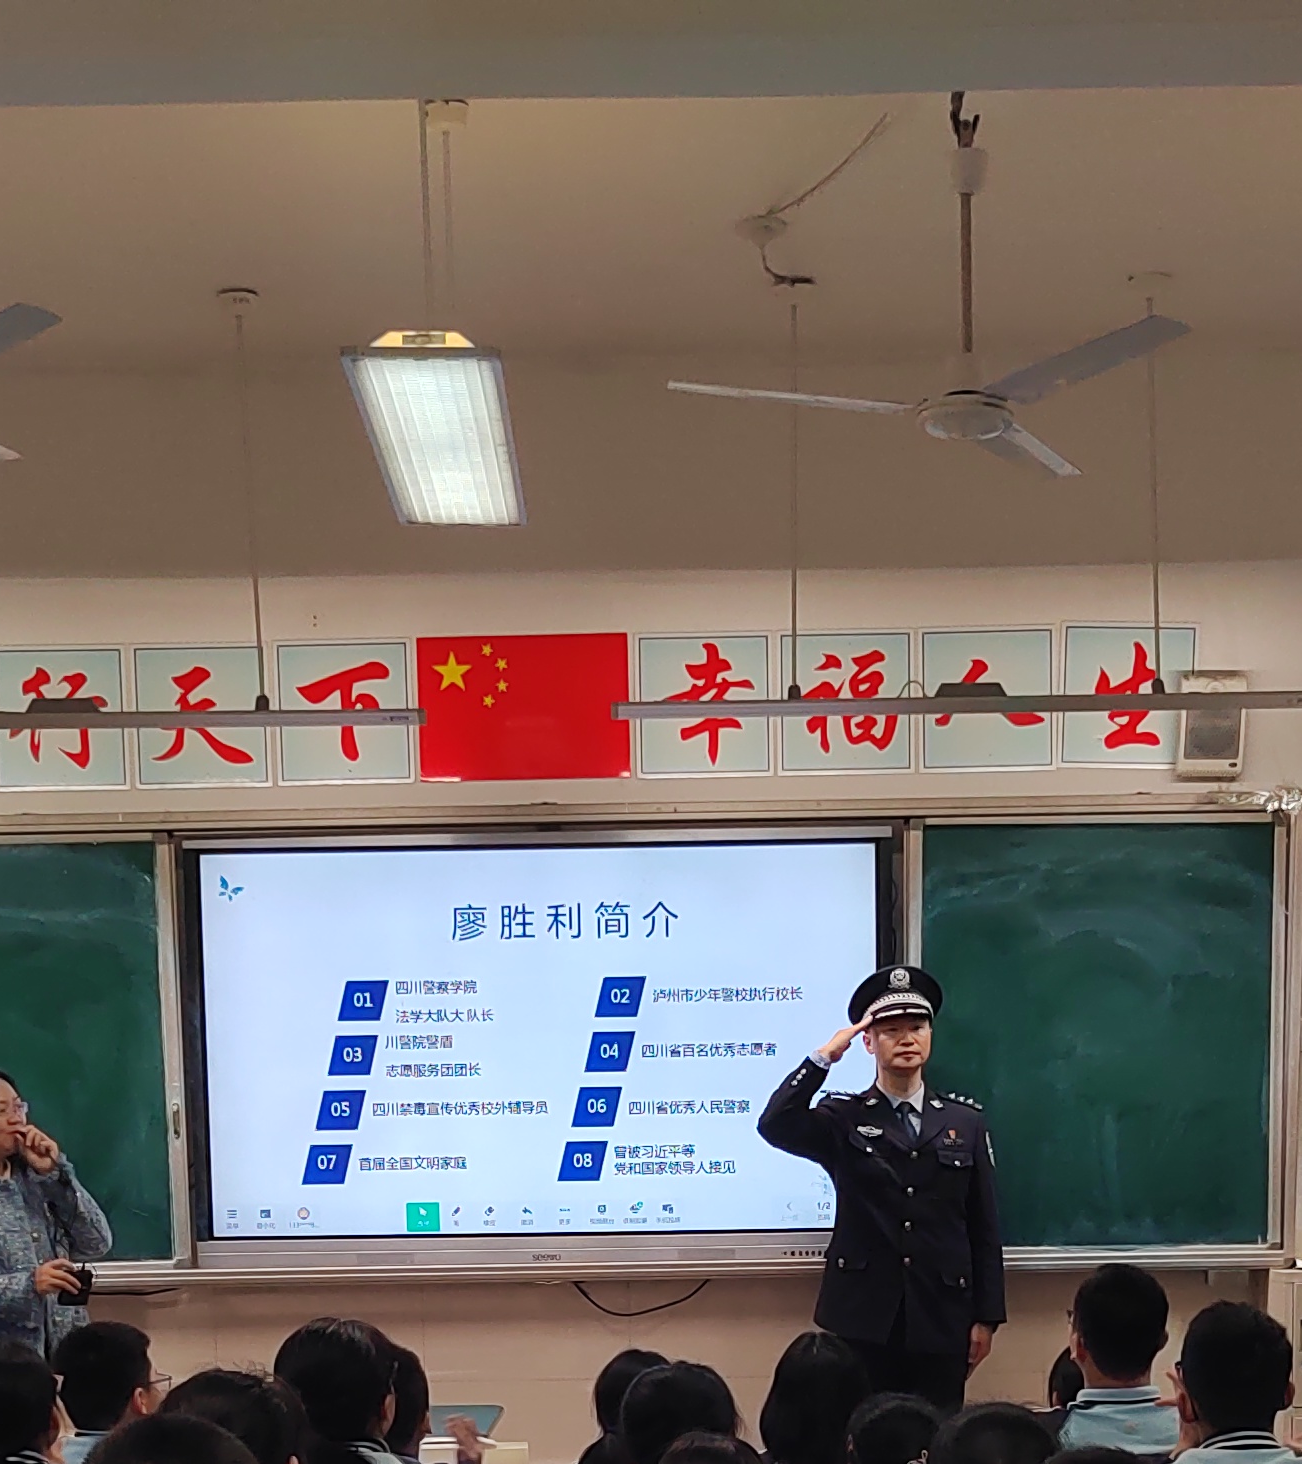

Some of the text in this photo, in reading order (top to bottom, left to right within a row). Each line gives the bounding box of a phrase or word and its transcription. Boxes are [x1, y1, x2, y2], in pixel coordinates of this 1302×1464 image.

[452, 901, 679, 942] 廖胜利简介
[395, 980, 478, 995] 四川警察学院
[652, 986, 803, 1003] 泸州市少年警校执行校长
[353, 992, 374, 1008] 01
[610, 989, 630, 1004] 02
[395, 1009, 494, 1023] 法学大队大队长
[385, 1035, 453, 1049] 川警院警盾
[343, 1047, 363, 1062] 03
[600, 1043, 619, 1059] 04
[641, 1042, 778, 1058] 四川省百名优秀志愿者
[386, 1062, 482, 1078] 志愿服务团团长
[330, 1102, 350, 1117] 05
[372, 1101, 549, 1117] 四川禁毒宣传优秀校外辅导员
[587, 1098, 607, 1113] 06
[628, 1100, 750, 1115] 四川省优秀人民警察
[614, 1144, 696, 1159] 曾被习近平等
[317, 1155, 337, 1170] 07
[359, 1156, 468, 1171] 首届全国文明家庭
[573, 1153, 593, 1168] 08
[614, 1160, 736, 1176] 党和国家领导人接见
[817, 1201, 831, 1210] 1/2
